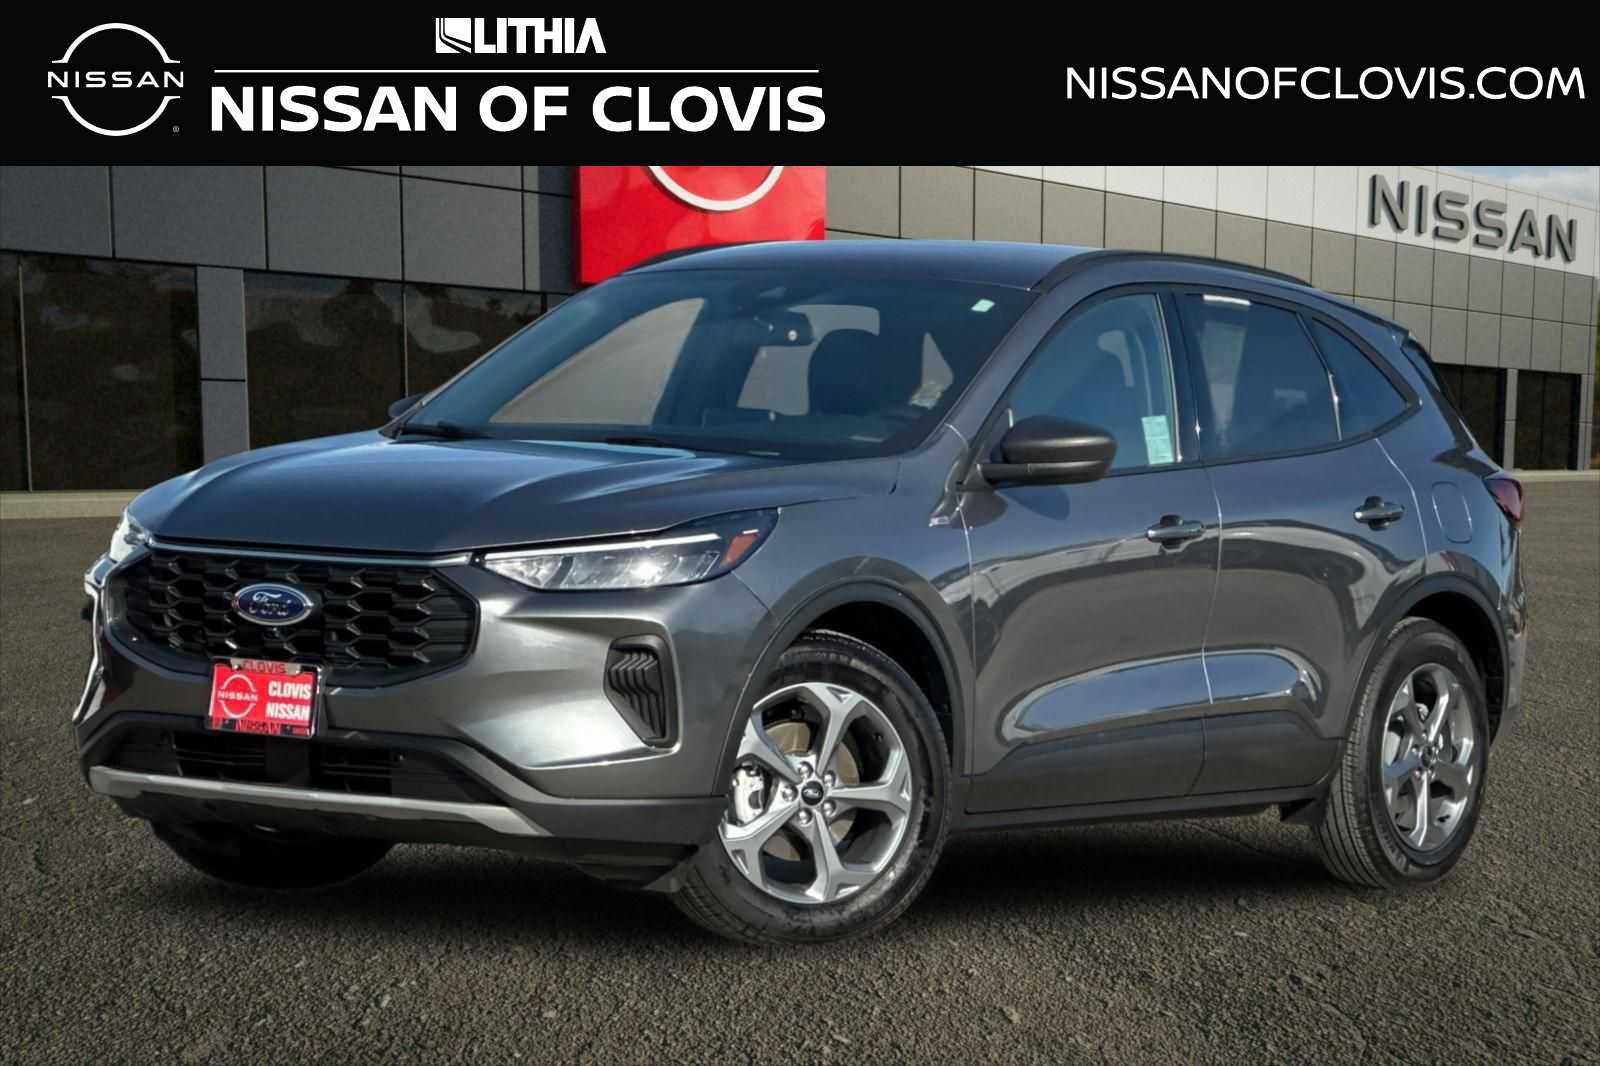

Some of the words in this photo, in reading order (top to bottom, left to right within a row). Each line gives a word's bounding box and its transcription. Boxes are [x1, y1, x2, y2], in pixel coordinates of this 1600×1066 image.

[1368, 174, 1577, 263] NISSAN
[243, 660, 286, 674] CLOVIS
[217, 691, 258, 701] NISSAN
[268, 680, 311, 700] CLOVIS
[265, 702, 311, 721] NISSAN
